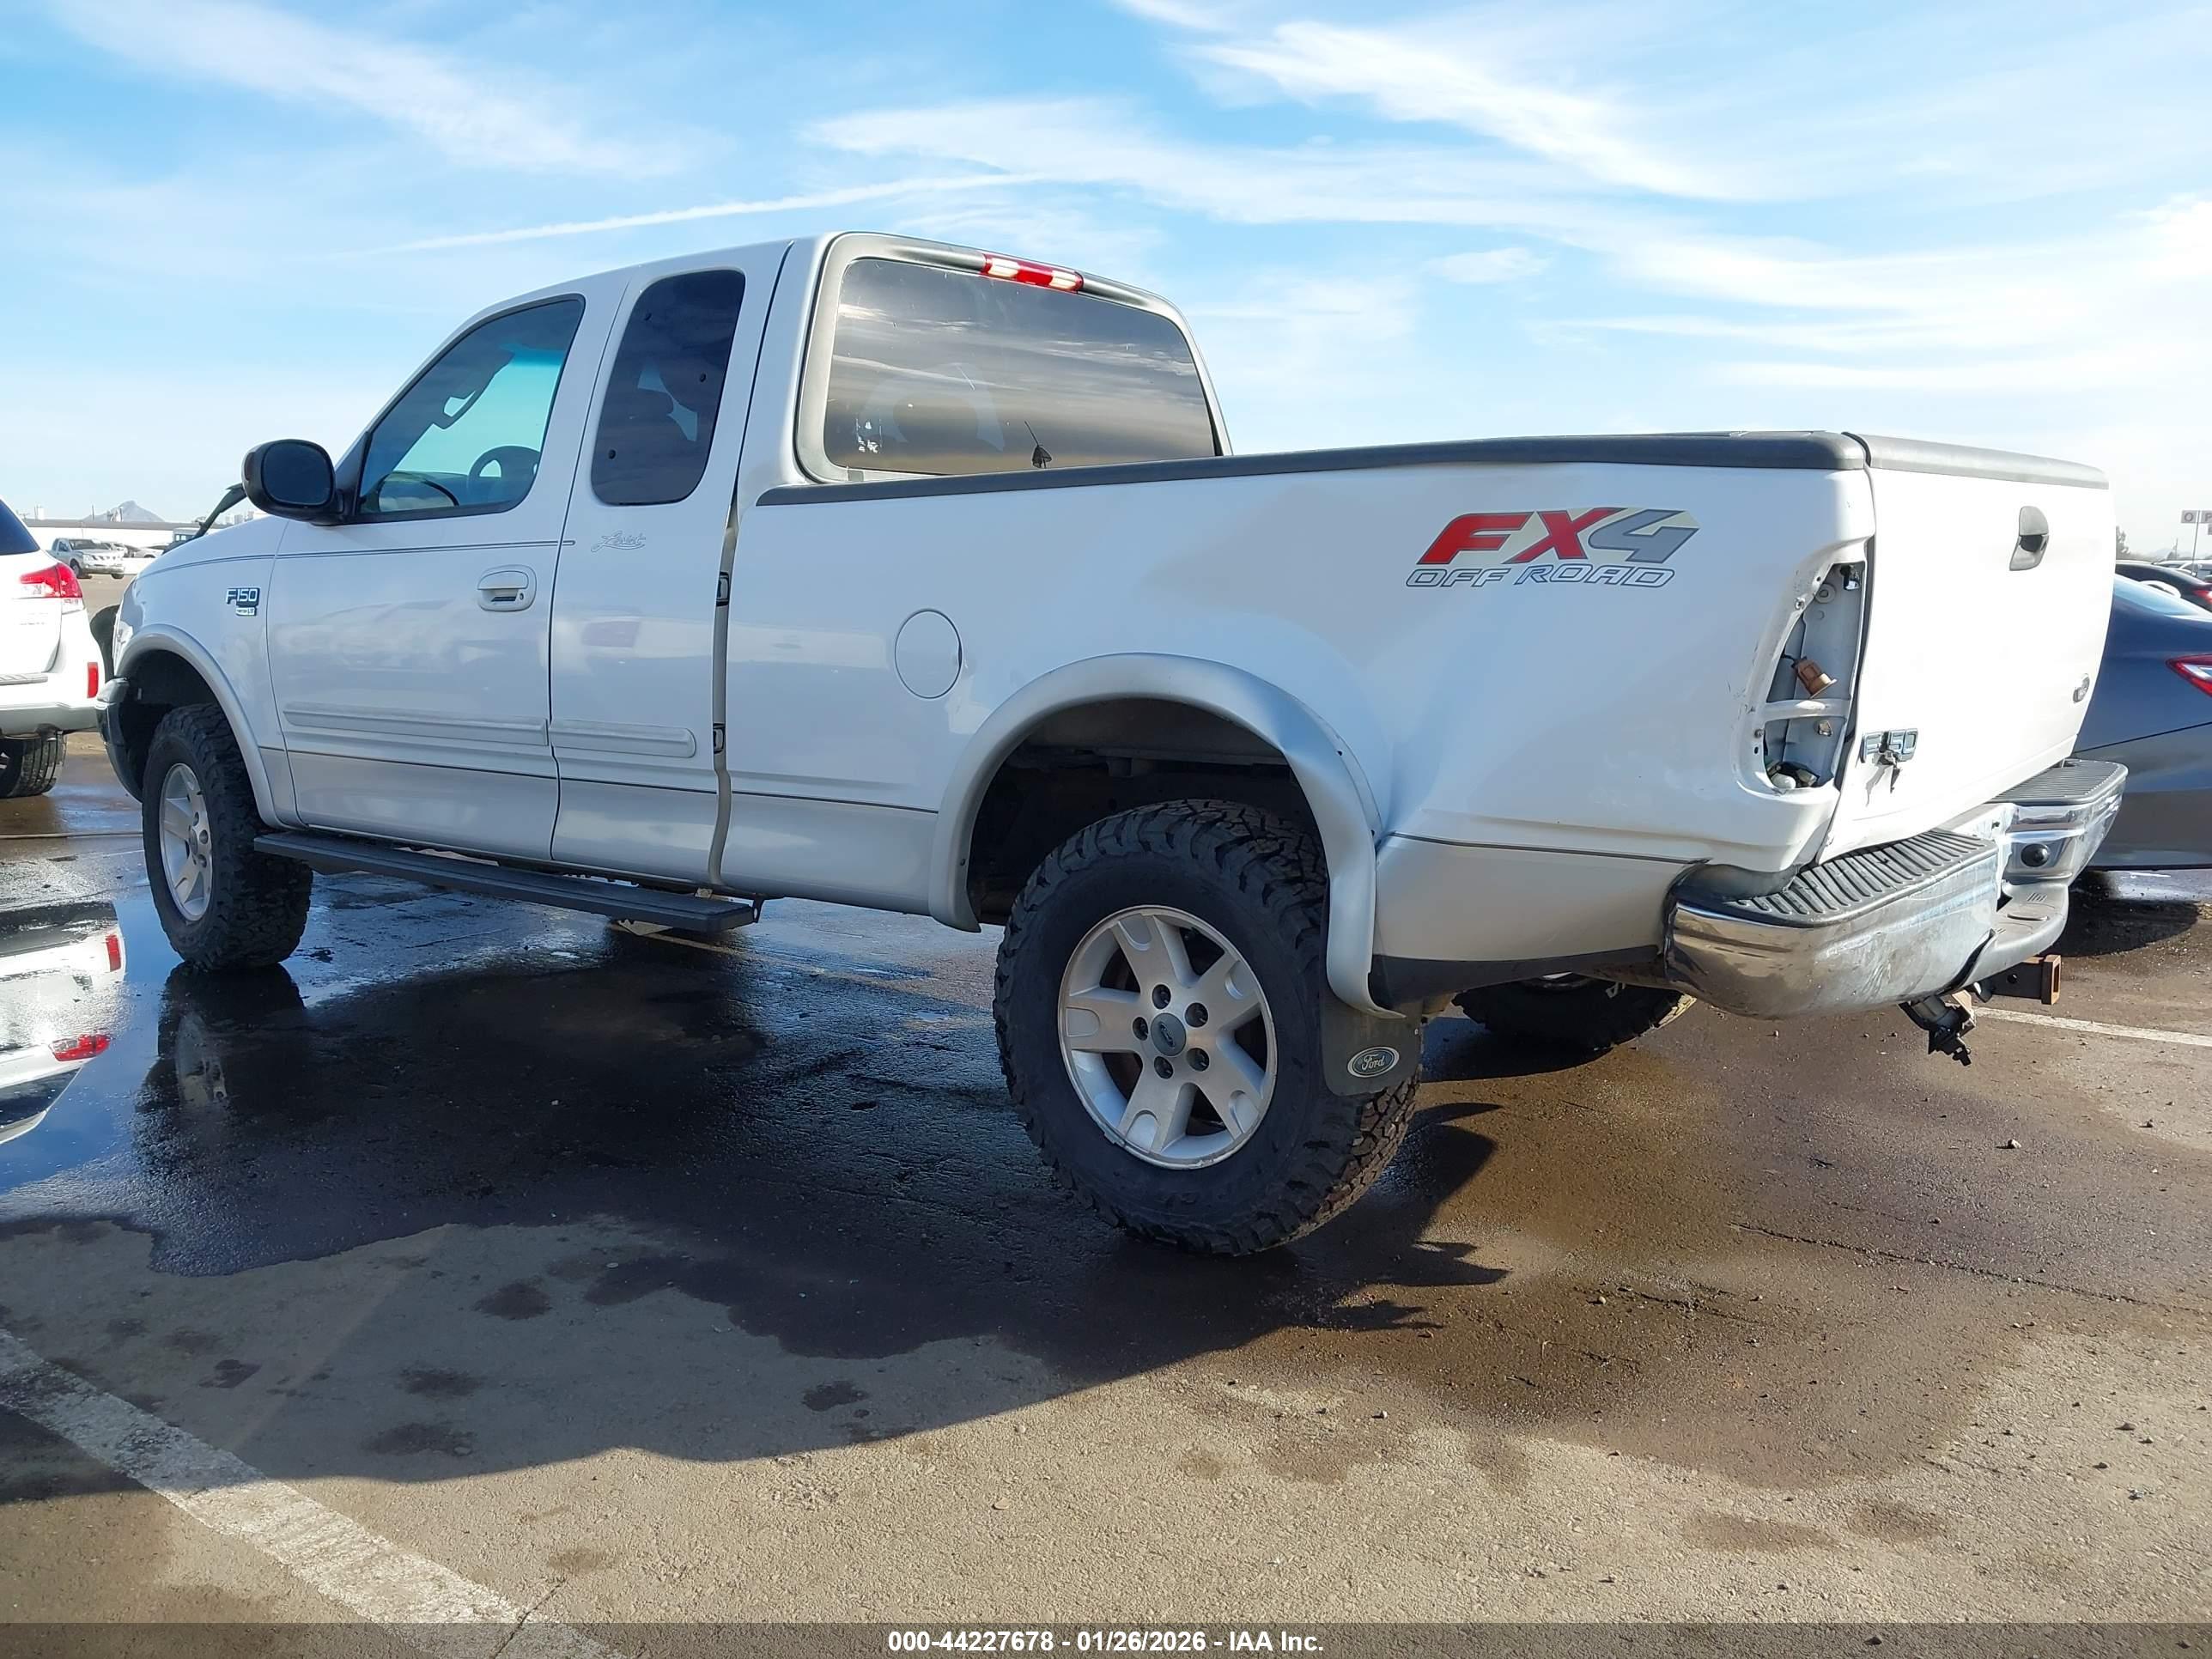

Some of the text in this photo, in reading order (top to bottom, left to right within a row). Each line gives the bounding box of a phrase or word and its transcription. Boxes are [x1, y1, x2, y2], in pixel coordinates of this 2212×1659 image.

[1416, 507, 1700, 565] FX4
[1405, 563, 1675, 588] OFF ROAD
[1860, 728, 1918, 763] F50
[1361, 1053, 1386, 1071] Ford
